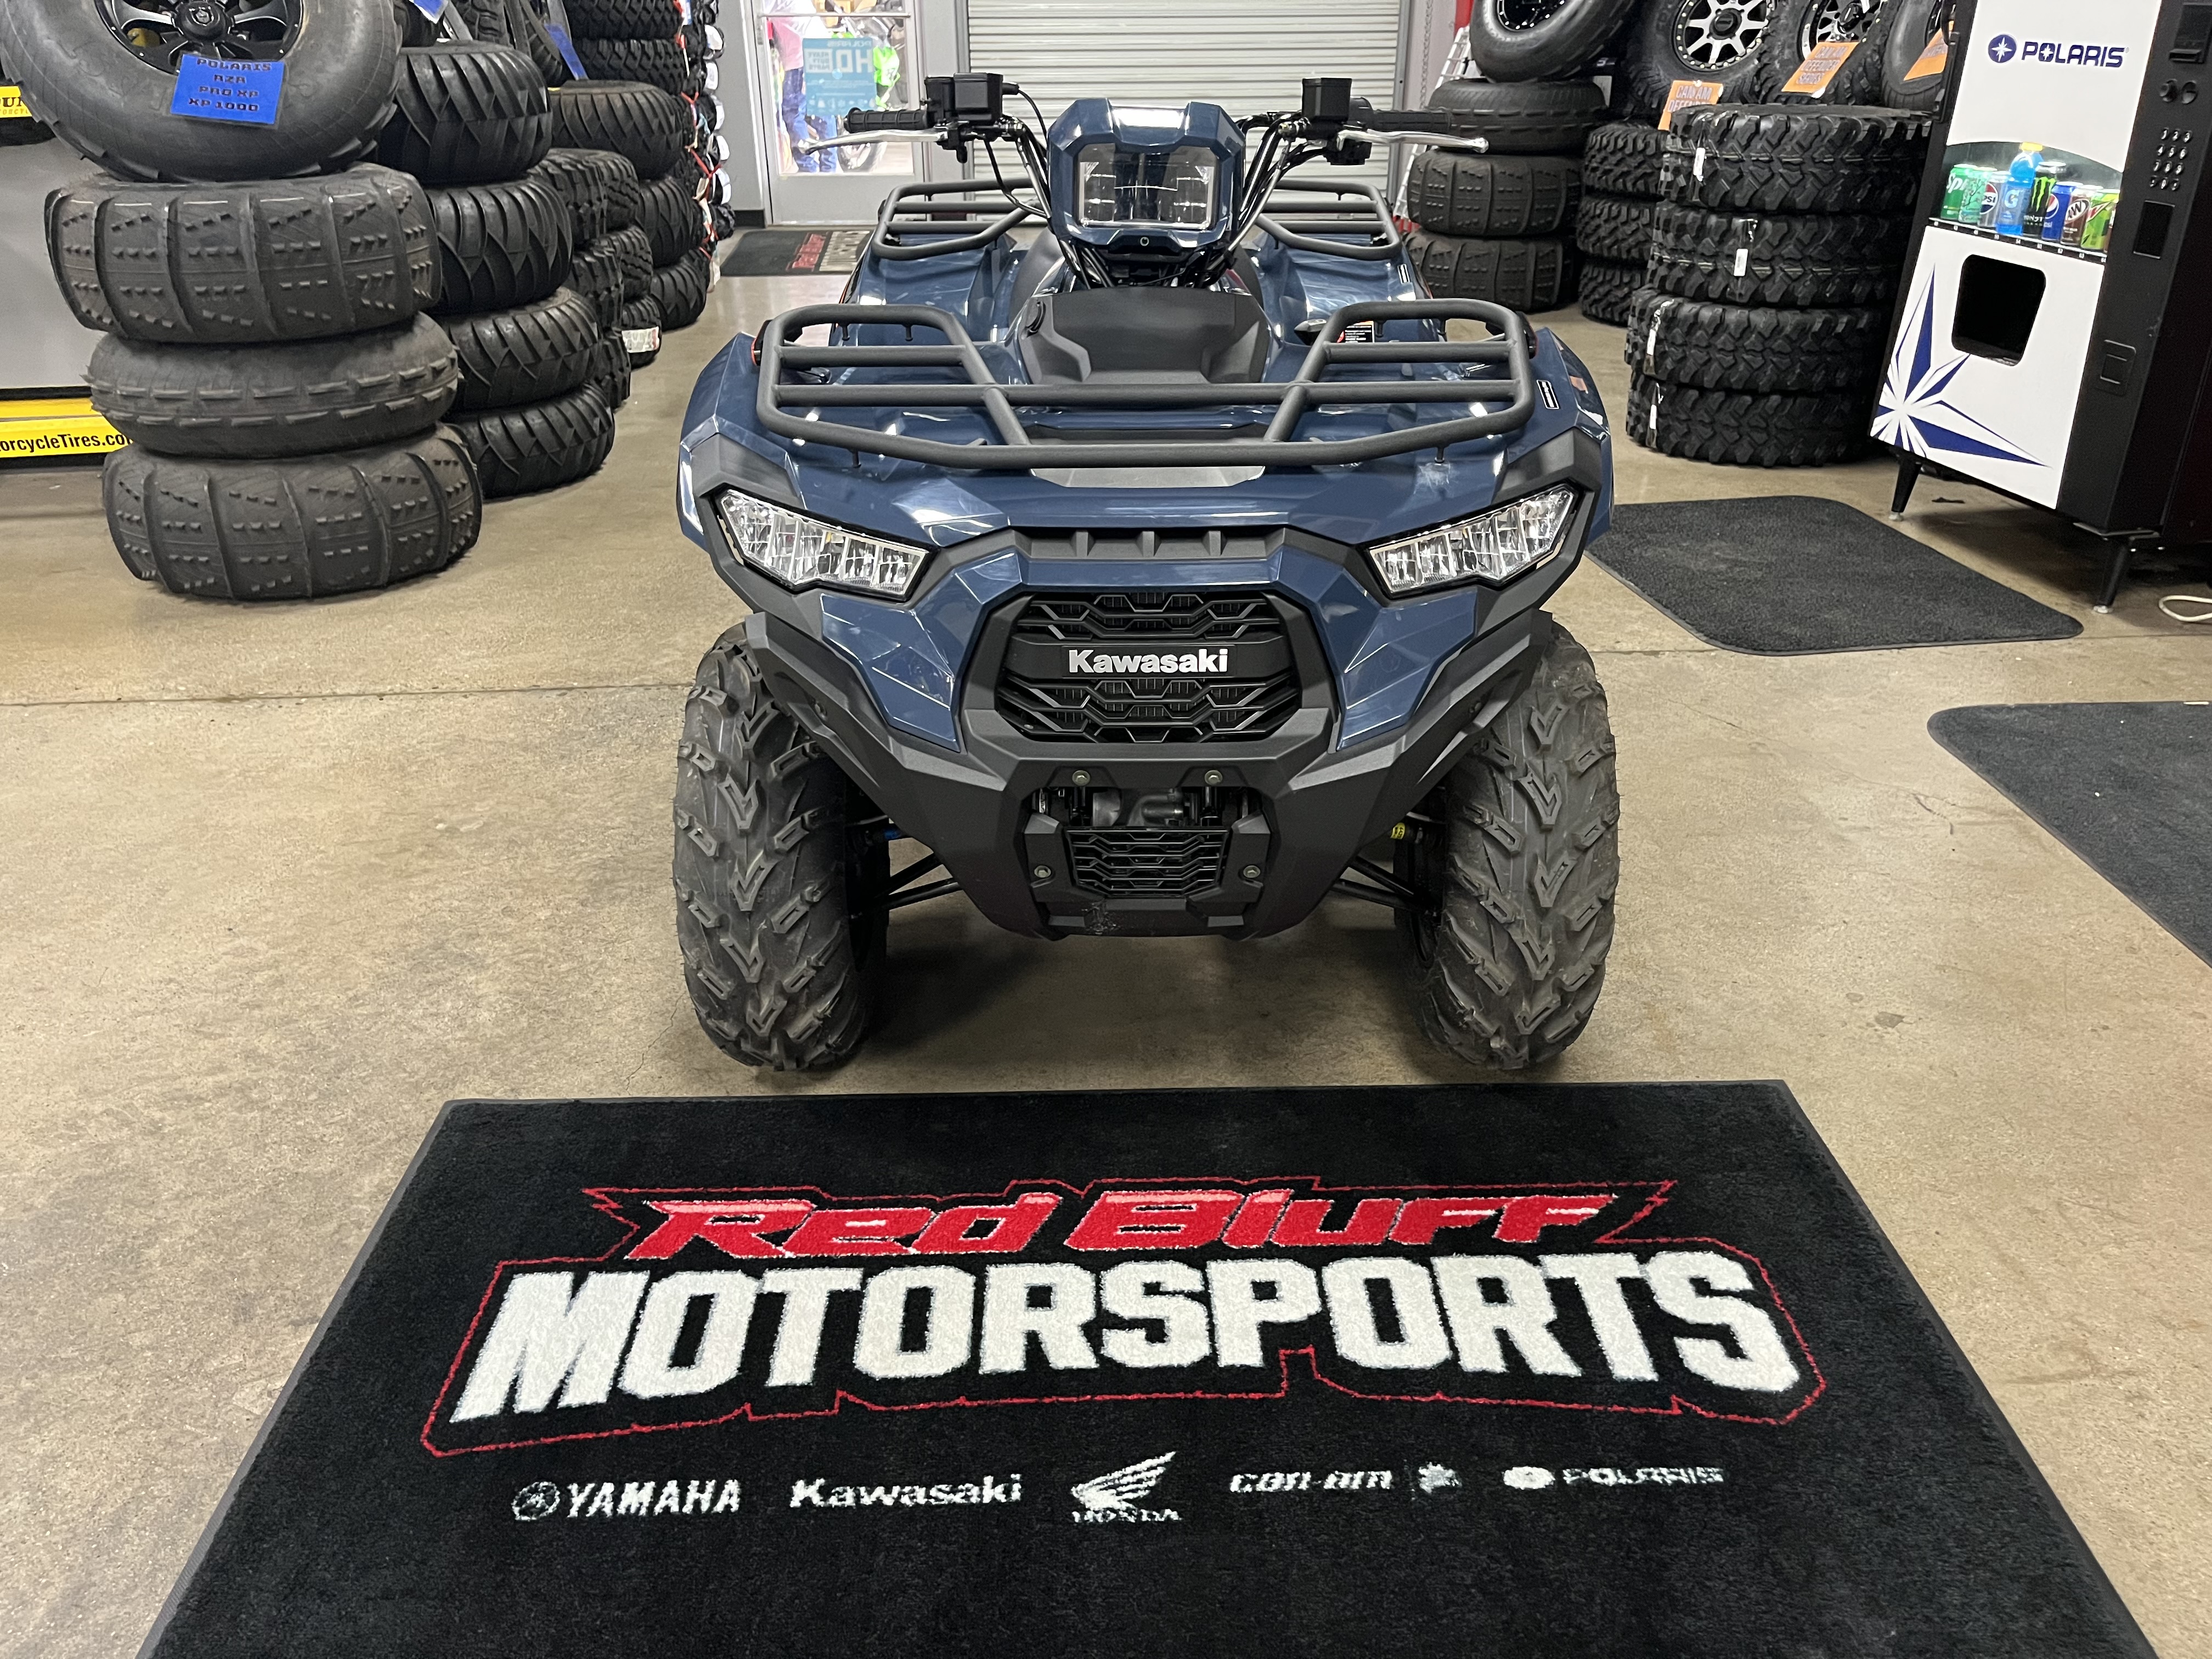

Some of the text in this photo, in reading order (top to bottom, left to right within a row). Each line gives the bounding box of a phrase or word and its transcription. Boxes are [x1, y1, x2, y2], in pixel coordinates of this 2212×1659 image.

[196, 58, 271, 71] POLARIS
[2022, 41, 2125, 67] POLARIS
[1676, 86, 1712, 100] CAN AM
[188, 98, 258, 111] XP 1000
[0, 433, 131, 453] orcycleTires.co
[1069, 648, 1228, 673] Kawasaki
[449, 1250, 1802, 1425] MOTORSPORTS
[567, 1479, 741, 1518] YAMAHA
[789, 1474, 1022, 1509] Kawasaki
[1562, 1466, 1724, 1487] POLARIS
